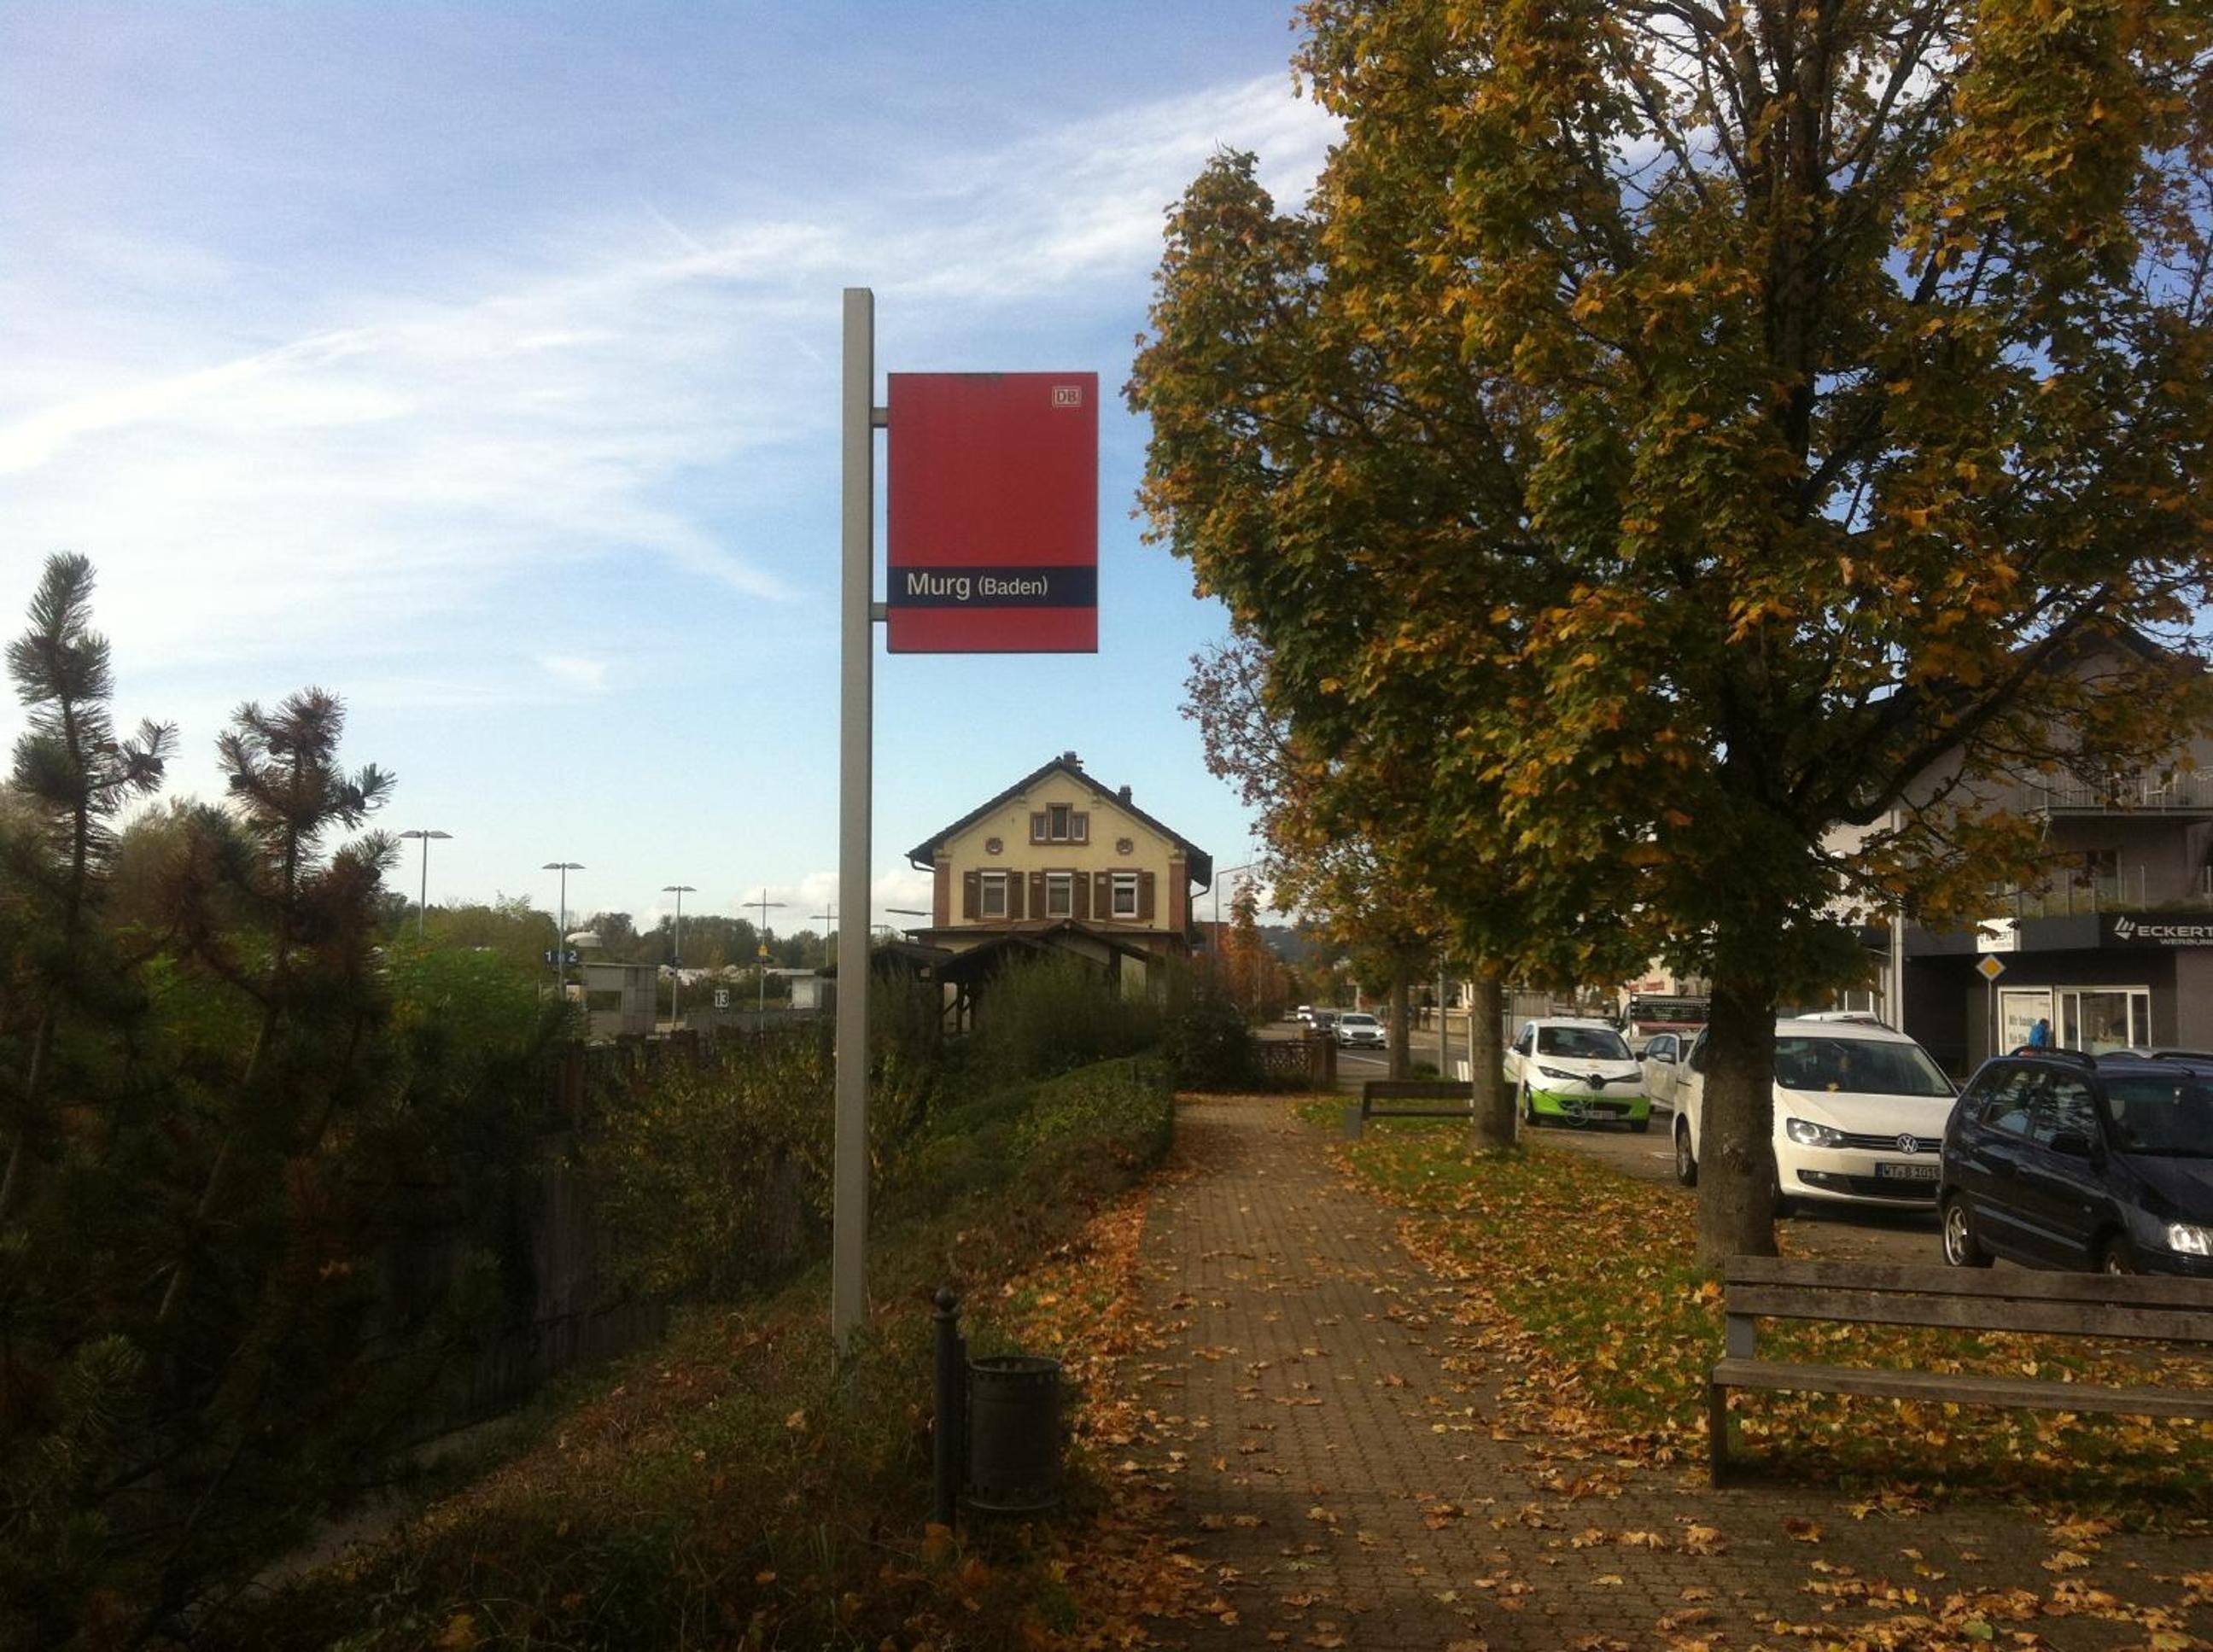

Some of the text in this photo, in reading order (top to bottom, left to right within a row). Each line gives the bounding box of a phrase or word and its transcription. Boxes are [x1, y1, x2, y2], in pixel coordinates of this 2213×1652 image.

[908, 572, 1048, 601] Murg (Baden)
[2137, 925, 2213, 937] ECKERT
[568, 950, 577, 963] 2
[716, 991, 728, 1006] 13
